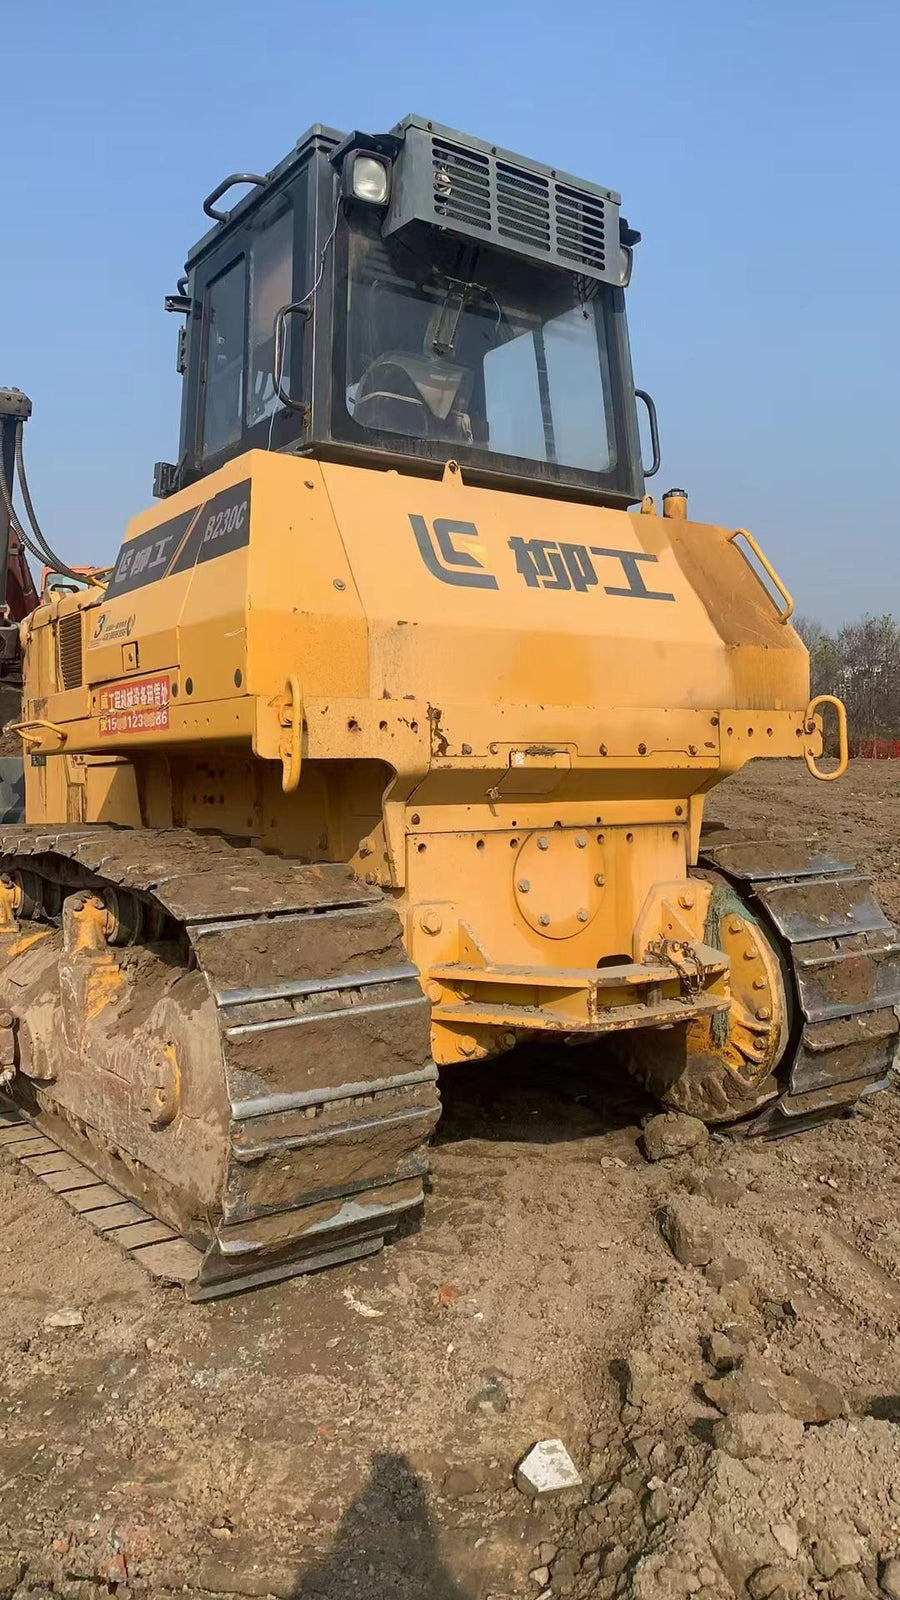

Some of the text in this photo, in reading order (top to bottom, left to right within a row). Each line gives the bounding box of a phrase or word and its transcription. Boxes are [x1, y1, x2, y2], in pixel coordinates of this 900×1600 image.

[204, 501, 247, 542] B230C
[130, 535, 173, 577] 柳工
[507, 535, 676, 601] 柳工
[107, 711, 167, 730] 1512386
